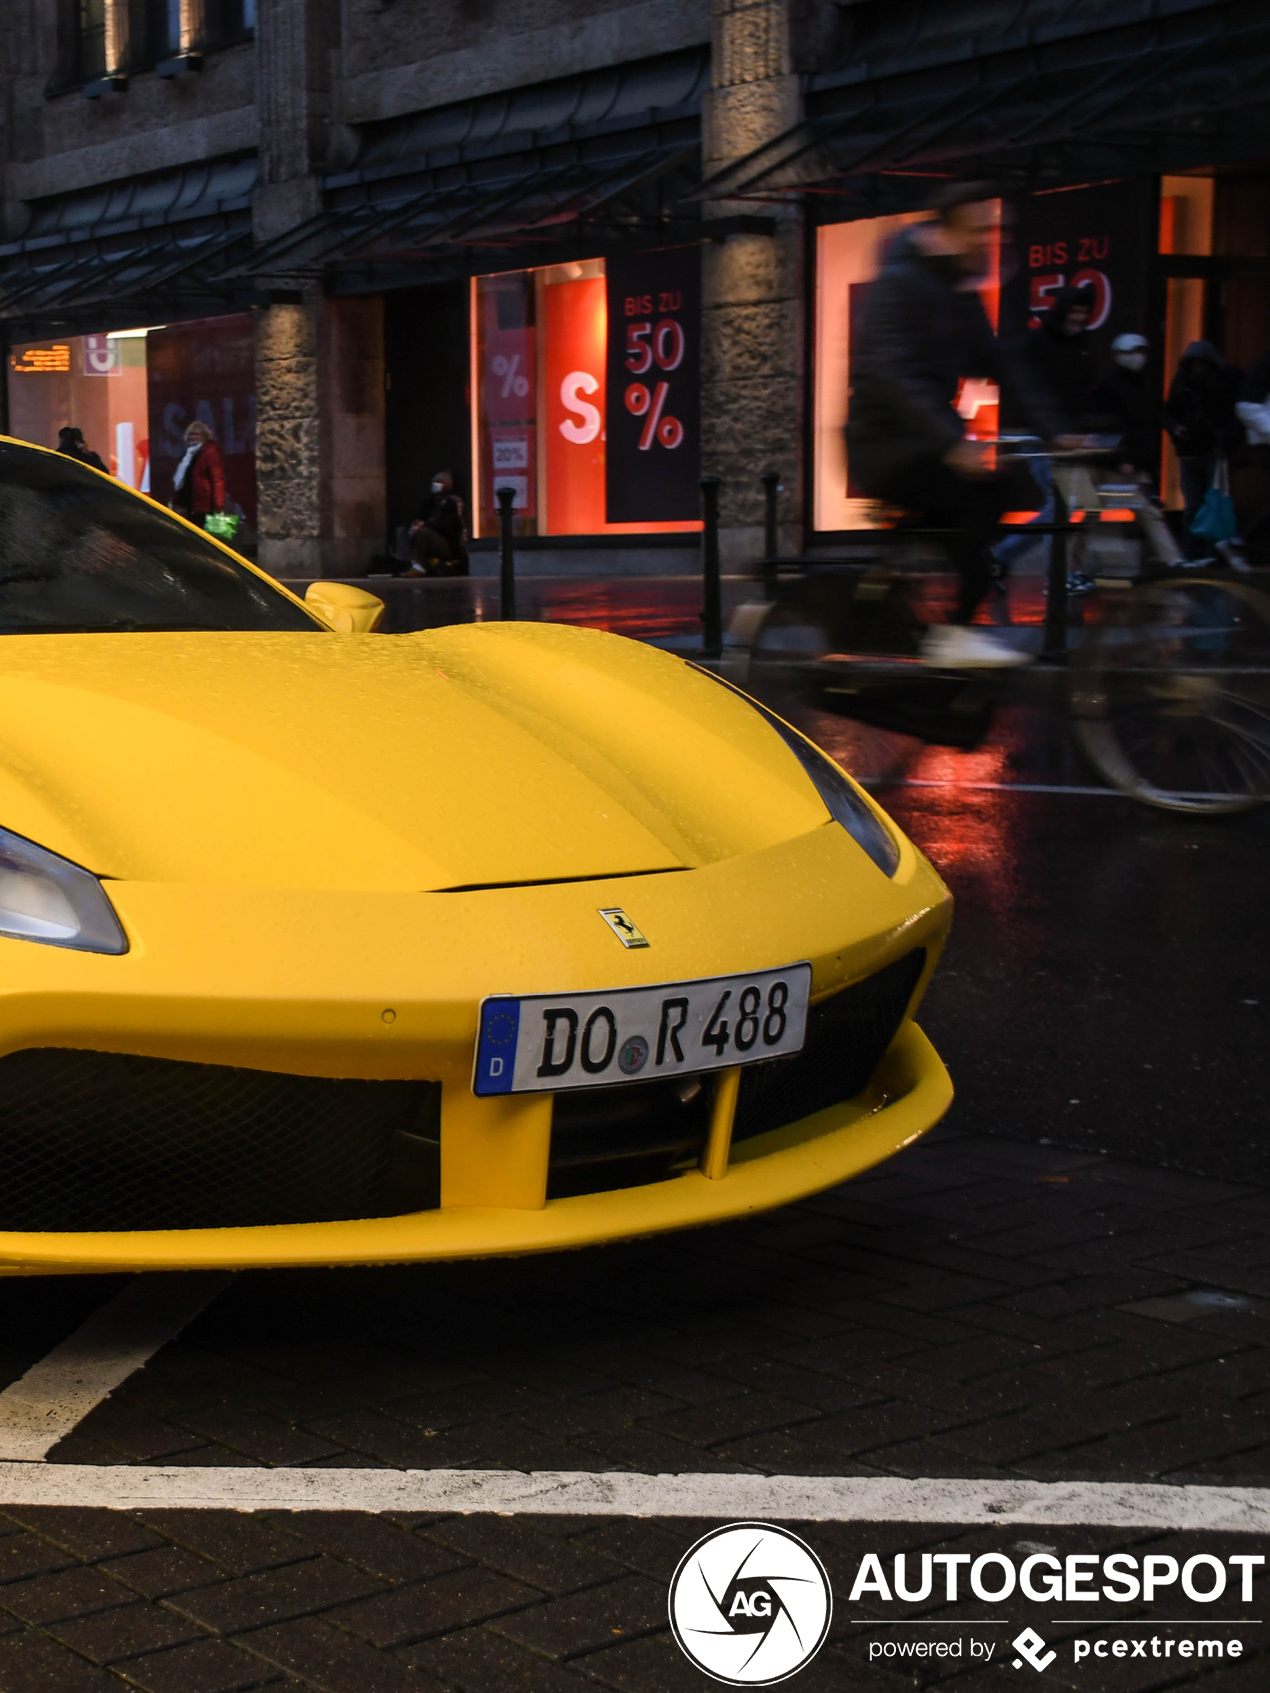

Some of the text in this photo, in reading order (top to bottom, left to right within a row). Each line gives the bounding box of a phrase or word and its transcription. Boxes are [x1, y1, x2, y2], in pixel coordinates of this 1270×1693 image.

[1029, 238, 1110, 268] BIS ZU
[624, 292, 681, 316] BIS ZU
[625, 318, 685, 374] 50
[492, 354, 529, 398] %
[624, 381, 684, 450] %
[537, 1006, 617, 1078] DO
[655, 997, 689, 1066] R
[702, 981, 788, 1056] 488
[489, 1057, 504, 1077] D
